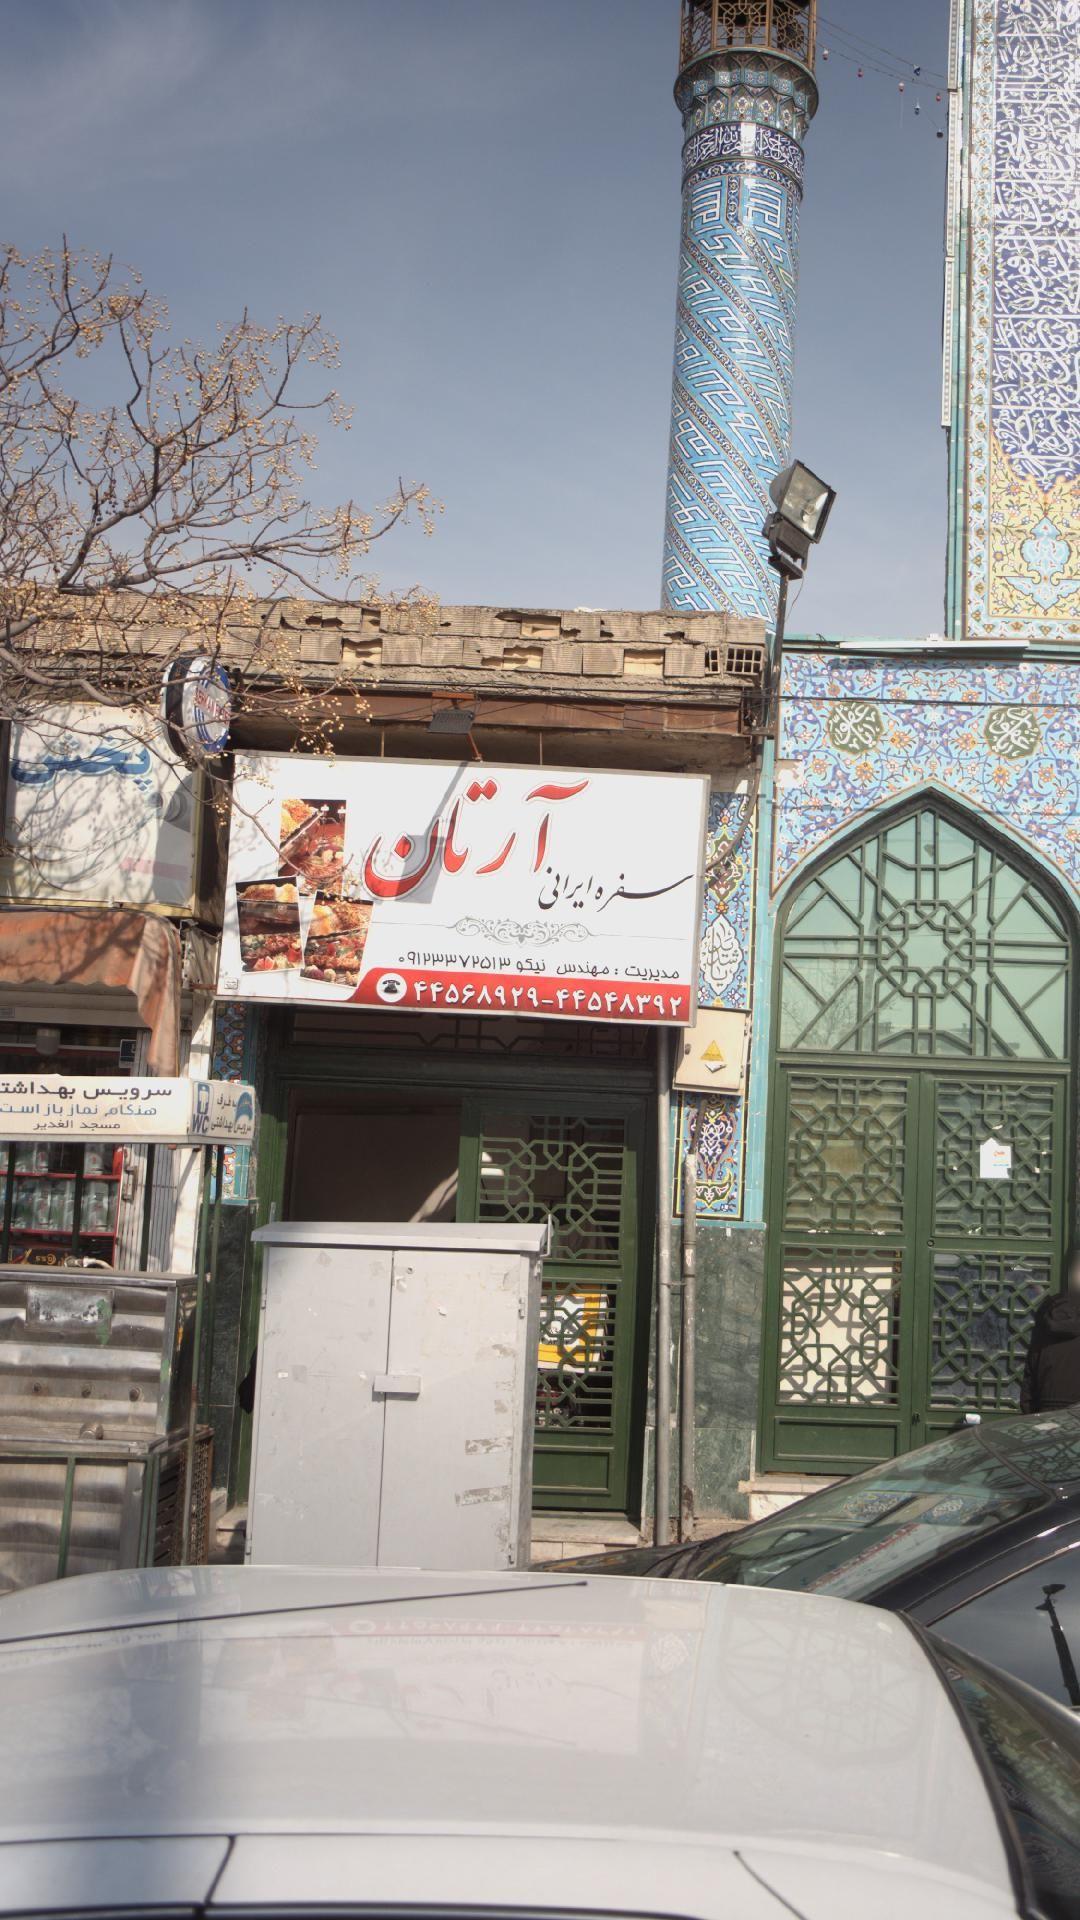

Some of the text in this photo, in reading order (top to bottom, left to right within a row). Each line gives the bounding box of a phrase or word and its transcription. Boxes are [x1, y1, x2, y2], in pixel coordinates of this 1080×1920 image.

[363, 778, 590, 899] آرتان
[538, 866, 695, 913] سفره ایرانی
[398, 951, 511, 970] ۰۹۱۲۳۳۷۲۵۱۳
[516, 958, 546, 974] نیکو
[556, 961, 610, 978] مهندس
[625, 964, 680, 982] مدیریت
[0, 1081, 172, 1101] سرویس بهداشت
[43, 1103, 63, 1117] باز
[66, 1103, 98, 1117] نماز
[33, 1119, 121, 1131] مسجد الغدیر
[192, 1114, 210, 1134] WC
